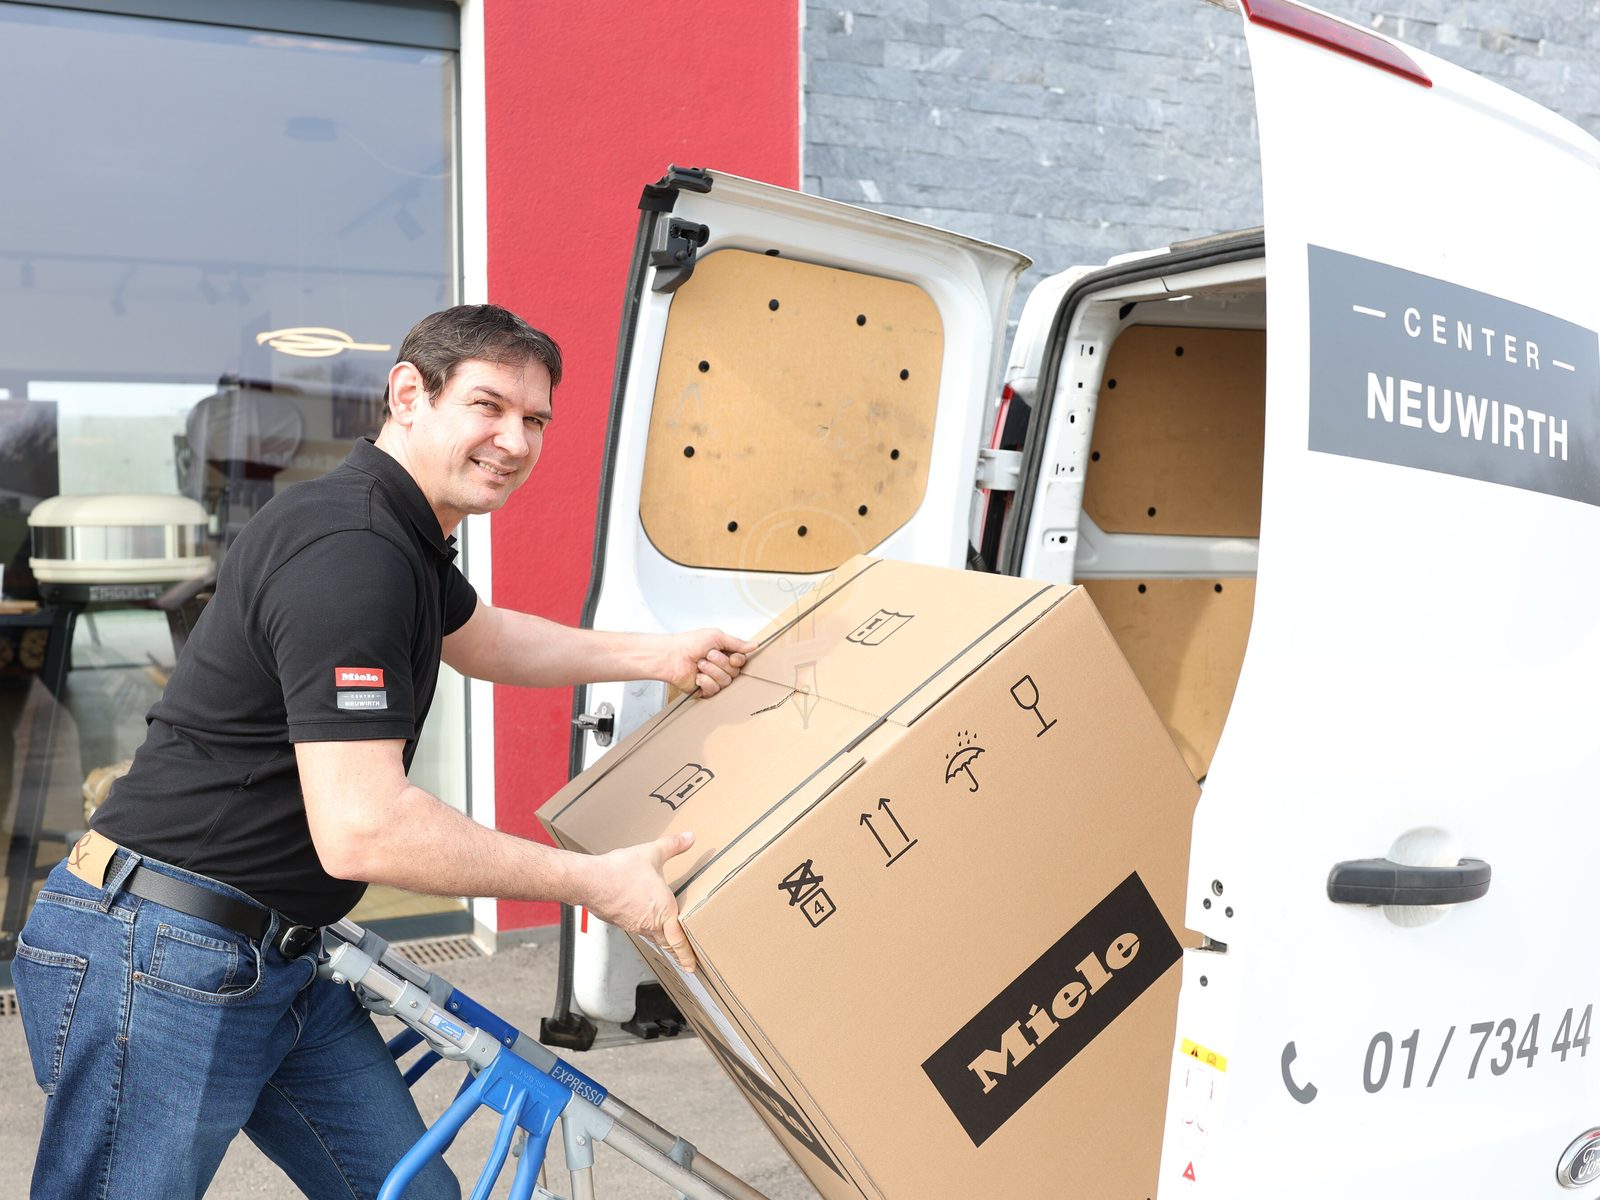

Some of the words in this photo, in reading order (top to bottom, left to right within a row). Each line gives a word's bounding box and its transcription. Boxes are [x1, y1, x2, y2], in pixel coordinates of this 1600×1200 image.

[1404, 307, 1540, 370] CENTER
[1367, 372, 1568, 461] NEUWIRTH
[341, 672, 379, 682] Miele
[814, 900, 825, 914] 4
[967, 932, 1140, 1094] Miele
[1362, 1029, 1420, 1094] 01
[1467, 1012, 1541, 1080] 734
[1551, 1003, 1594, 1063] 44
[551, 1065, 604, 1106] EXPRESSO
